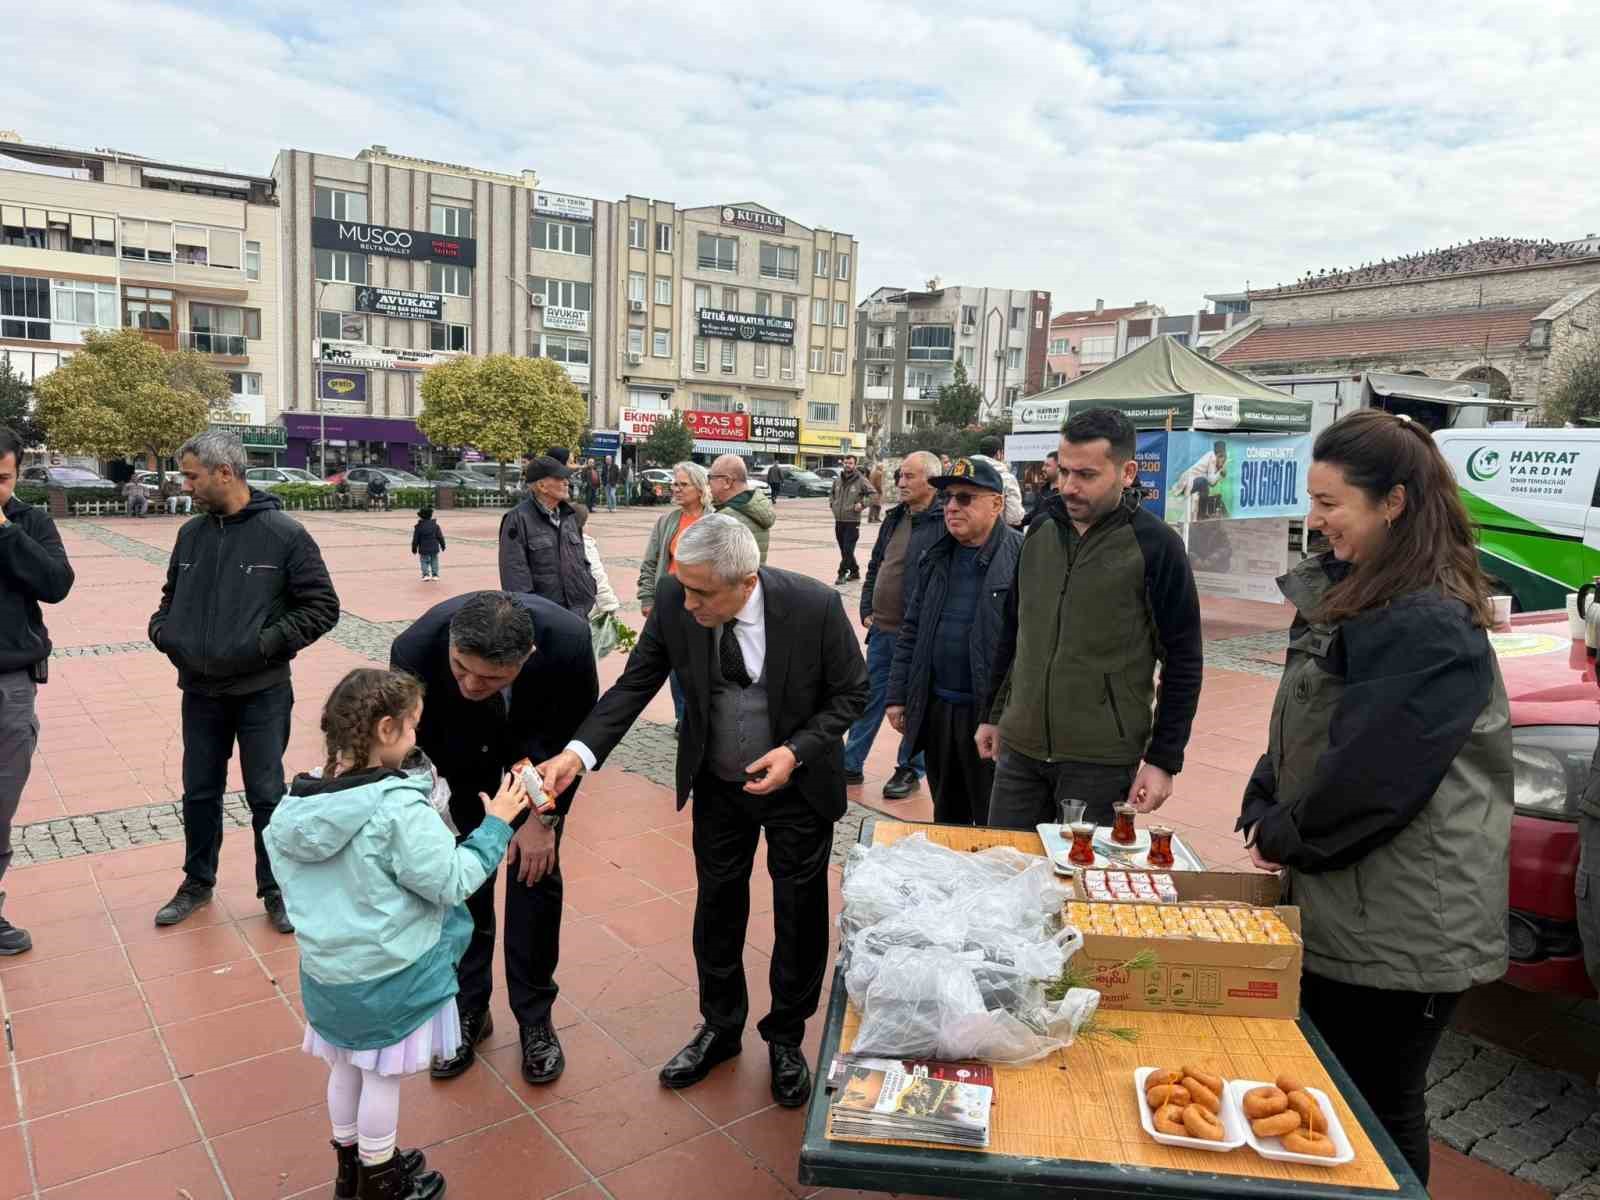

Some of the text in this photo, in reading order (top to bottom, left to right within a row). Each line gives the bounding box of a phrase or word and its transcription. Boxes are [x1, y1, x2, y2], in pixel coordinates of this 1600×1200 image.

[737, 210, 784, 226] KUTLUK
[339, 223, 412, 248] MUSOO
[379, 295, 435, 308] AVUKAT
[547, 307, 584, 319] AVUKAT
[753, 416, 797, 428] SAMSUNG
[764, 427, 795, 439] iPhone
[1510, 451, 1580, 463] HAYRAT
[1509, 466, 1572, 476] YARDIM
[1240, 459, 1298, 507] SU GİBİ OL
